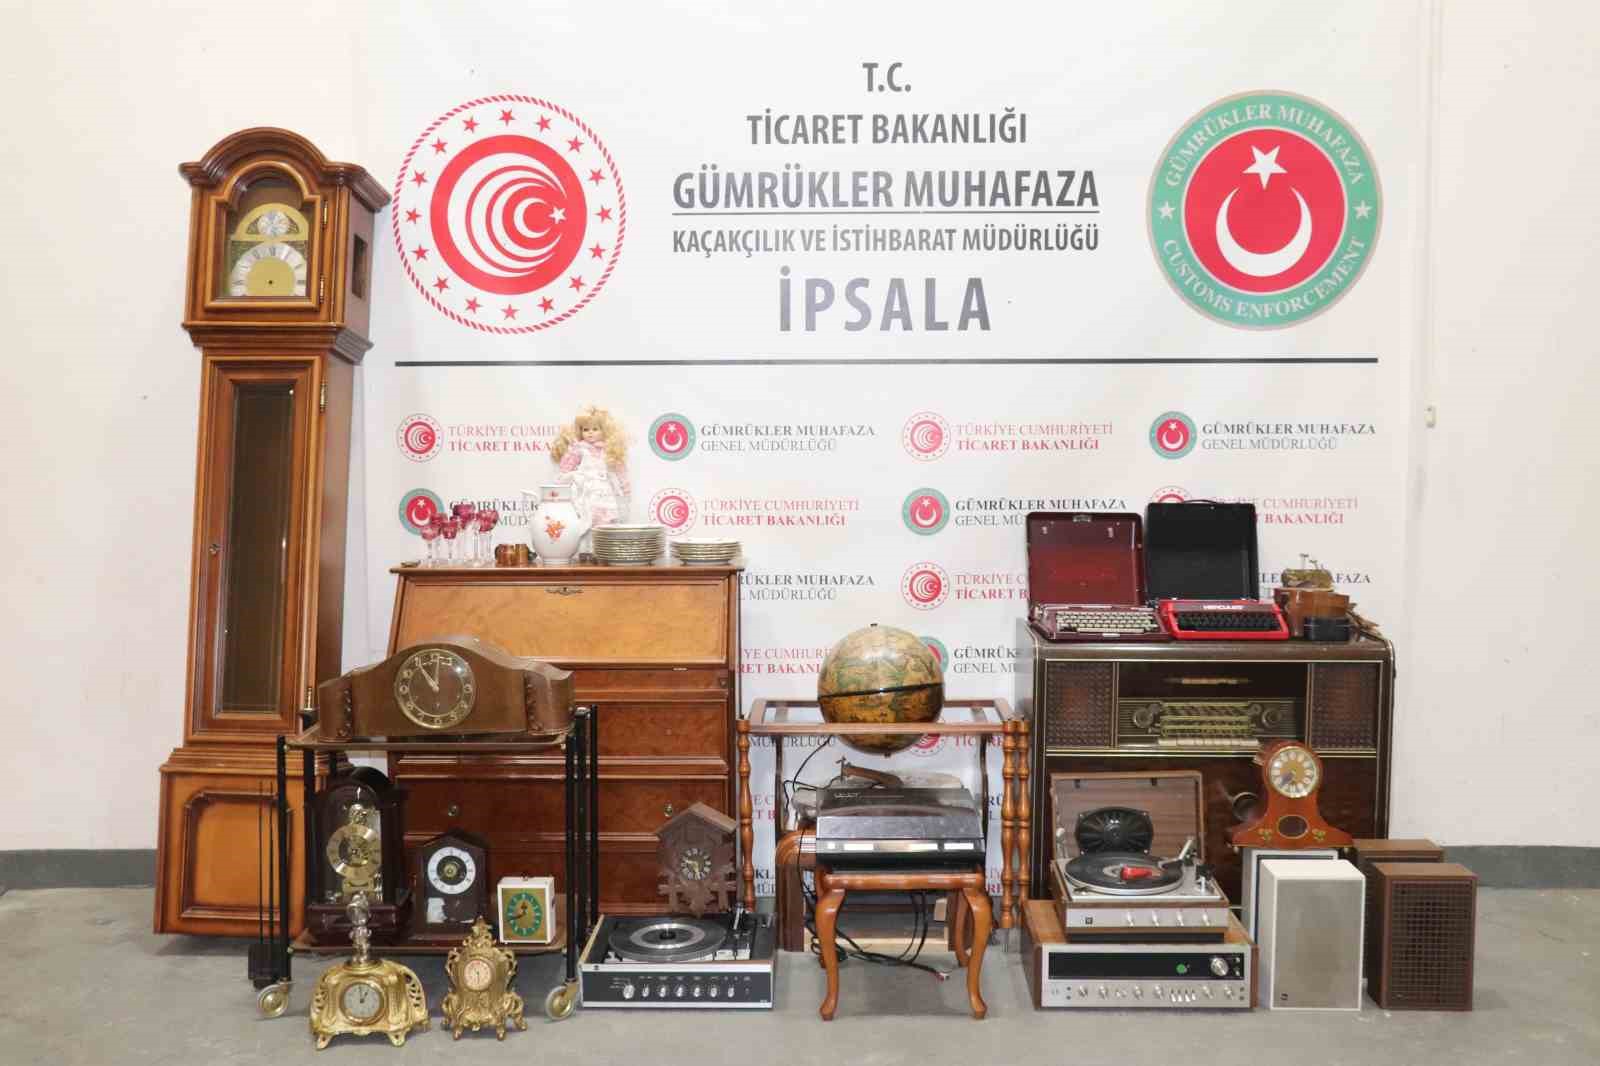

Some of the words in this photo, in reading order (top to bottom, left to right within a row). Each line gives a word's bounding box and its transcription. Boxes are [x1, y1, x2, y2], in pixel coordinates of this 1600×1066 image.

[862, 62, 912, 93] T.C.
[747, 107, 863, 145] TİCARET
[872, 107, 1027, 145] BAKANLIĞI
[1165, 103, 1273, 187] GÜMRÜKLER
[1279, 103, 1365, 185] MUHAFAZA
[673, 163, 894, 208] GÜMRÜKLER
[904, 169, 1100, 208] MUHAFAZA
[673, 228, 795, 259] KAÇAKÇILIK
[800, 229, 826, 252] VE
[832, 223, 957, 252] İSTİHBARAT
[963, 223, 1099, 252] MÜDÜRLÜĞÜ
[1163, 239, 1232, 313] CUSTOMS
[1235, 236, 1365, 318] ENFORCEMENT
[780, 265, 992, 332] İPSALA
[701, 423, 791, 436] GÜMRÜKLER
[796, 425, 875, 436] MUHAFAZA
[957, 421, 1016, 435] TÜRKİYE
[1019, 421, 1113, 435] CUMHURİYETİ
[1202, 422, 1293, 435] GÜMRÜKLER
[1298, 423, 1376, 434] MUHAFAZA
[449, 438, 507, 452] TİCARET
[701, 439, 746, 451] GENEL
[750, 438, 837, 451] MÜDÜRLÜĞÜ
[957, 438, 1018, 451] TİCARET
[1022, 438, 1099, 451] BAKANLIĞI
[1202, 438, 1247, 450] GENEL
[1250, 437, 1337, 450] MÜDÜRLÜĞÜ
[955, 499, 1046, 511] GÜMRÜKLER
[1049, 499, 1127, 510] MUHAFAZA
[704, 513, 764, 526] TİCARET
[767, 513, 848, 526] BAKANLIĞI
[955, 514, 1000, 527] GENEL
[1265, 512, 1344, 524] BAKANLIĞI
[796, 574, 875, 586] MUHAFAZA
[956, 587, 1014, 599] TİCARET
